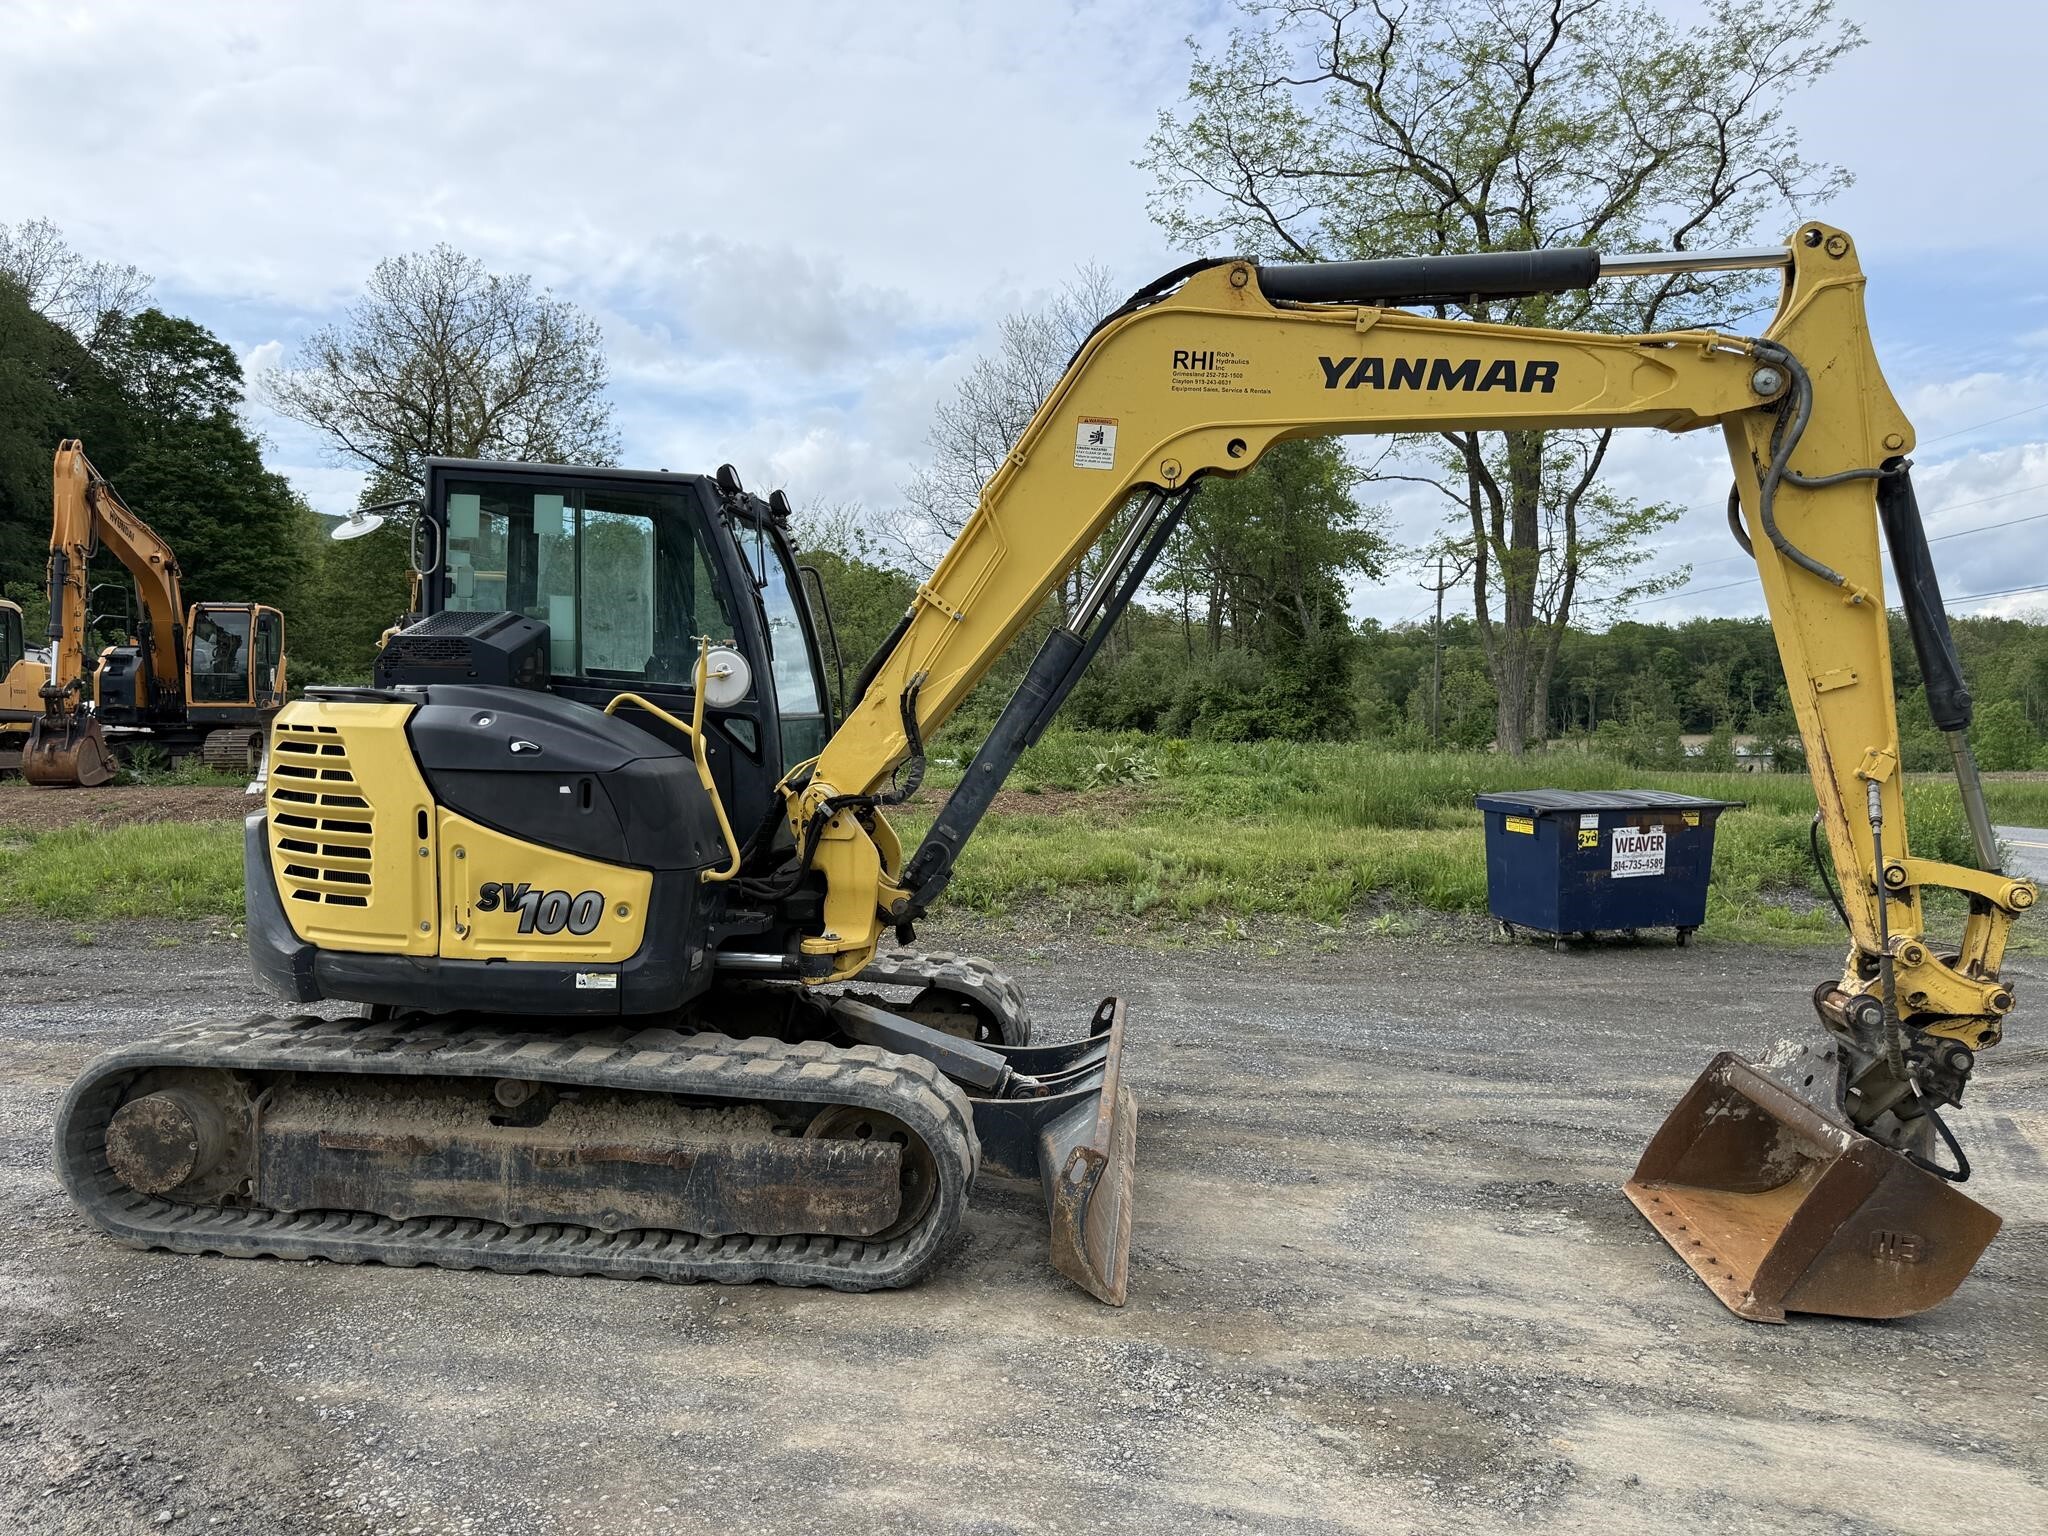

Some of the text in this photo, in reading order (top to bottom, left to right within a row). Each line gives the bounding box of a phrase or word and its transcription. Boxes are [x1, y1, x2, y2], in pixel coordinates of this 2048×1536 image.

[1173, 350, 1214, 370] RHI
[1318, 356, 1560, 393] YANMAR
[1171, 385, 1202, 393] Equipment
[1615, 835, 1664, 853] WEAVER
[1613, 858, 1664, 871] 814-735-4589
